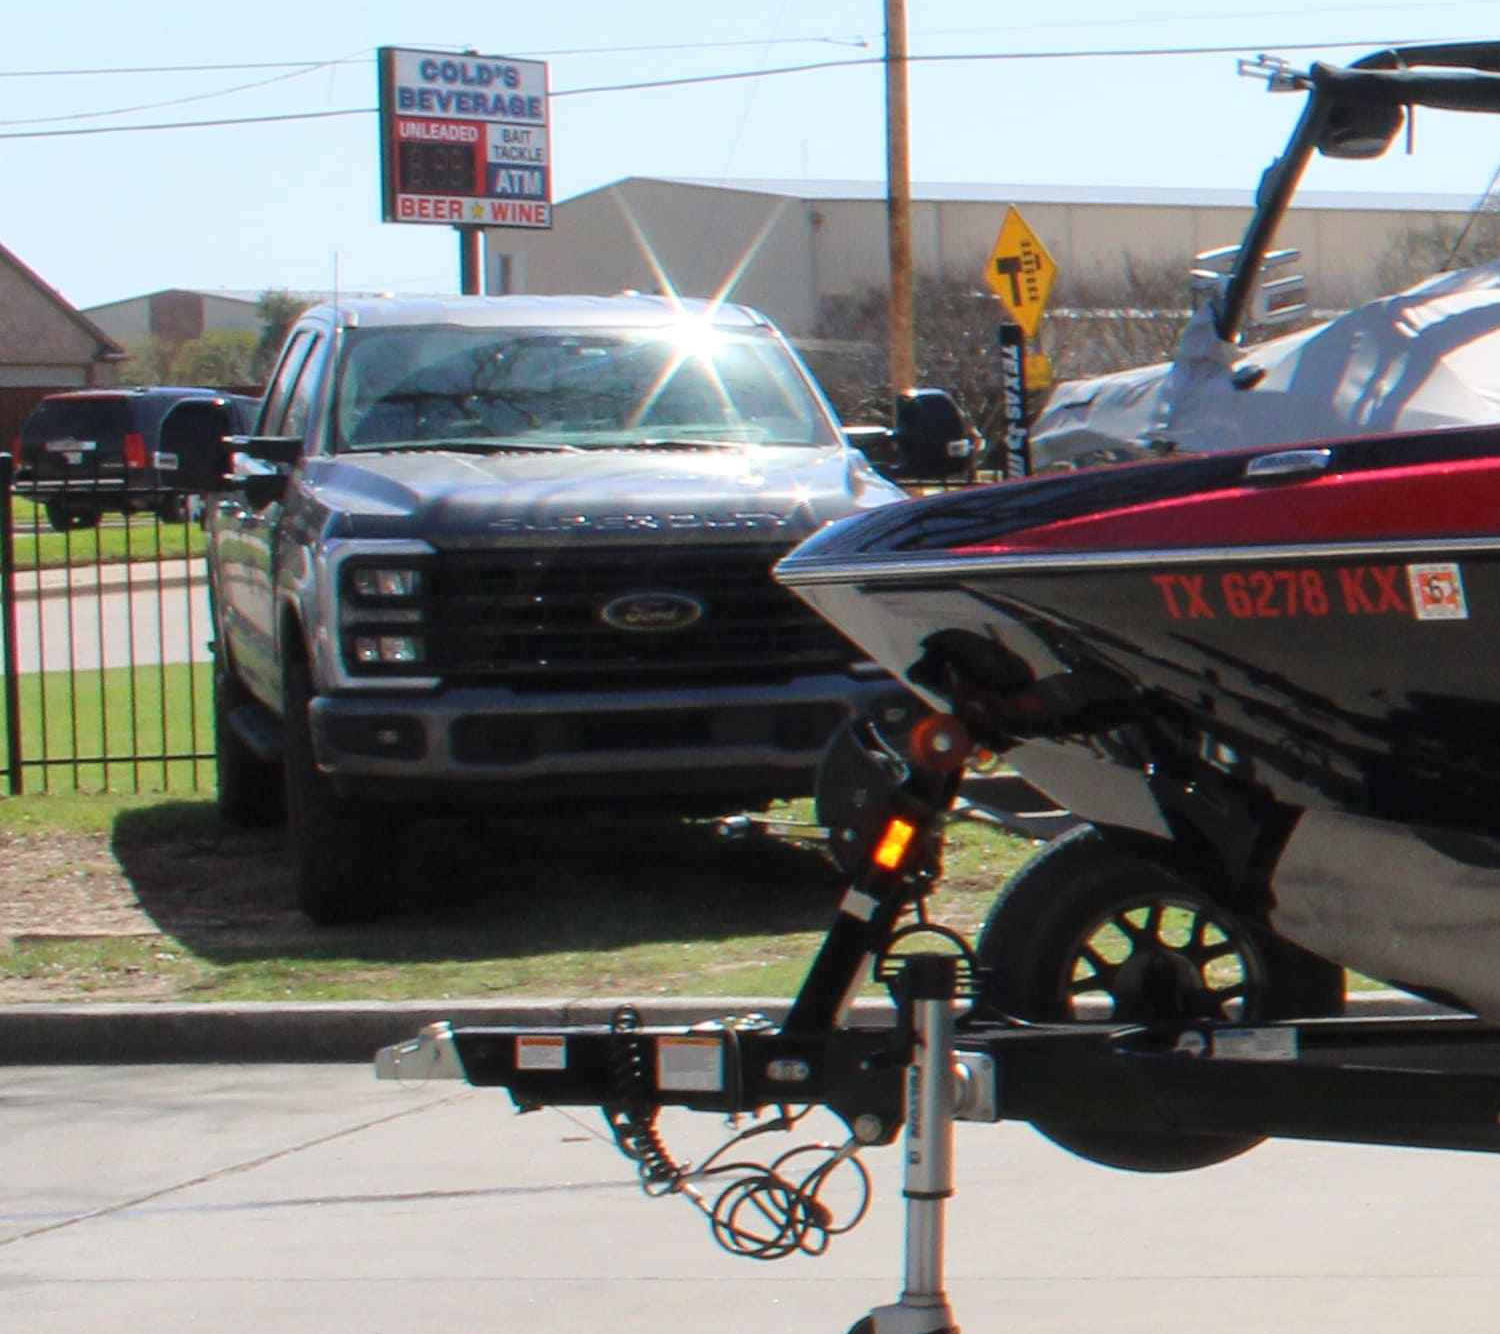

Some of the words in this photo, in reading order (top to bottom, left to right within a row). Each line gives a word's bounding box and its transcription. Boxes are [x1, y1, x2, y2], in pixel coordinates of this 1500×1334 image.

[397, 85, 544, 117] BEVERAGE
[399, 123, 479, 142] UNLEADED
[502, 128, 532, 143] BAIT
[493, 145, 543, 162] TACKLE
[496, 167, 544, 196] ATM
[401, 198, 465, 219] BEER
[491, 202, 545, 224] WINE
[1152, 574, 1215, 619] TX
[1220, 569, 1330, 618] 6278
[1338, 566, 1408, 615] KX
